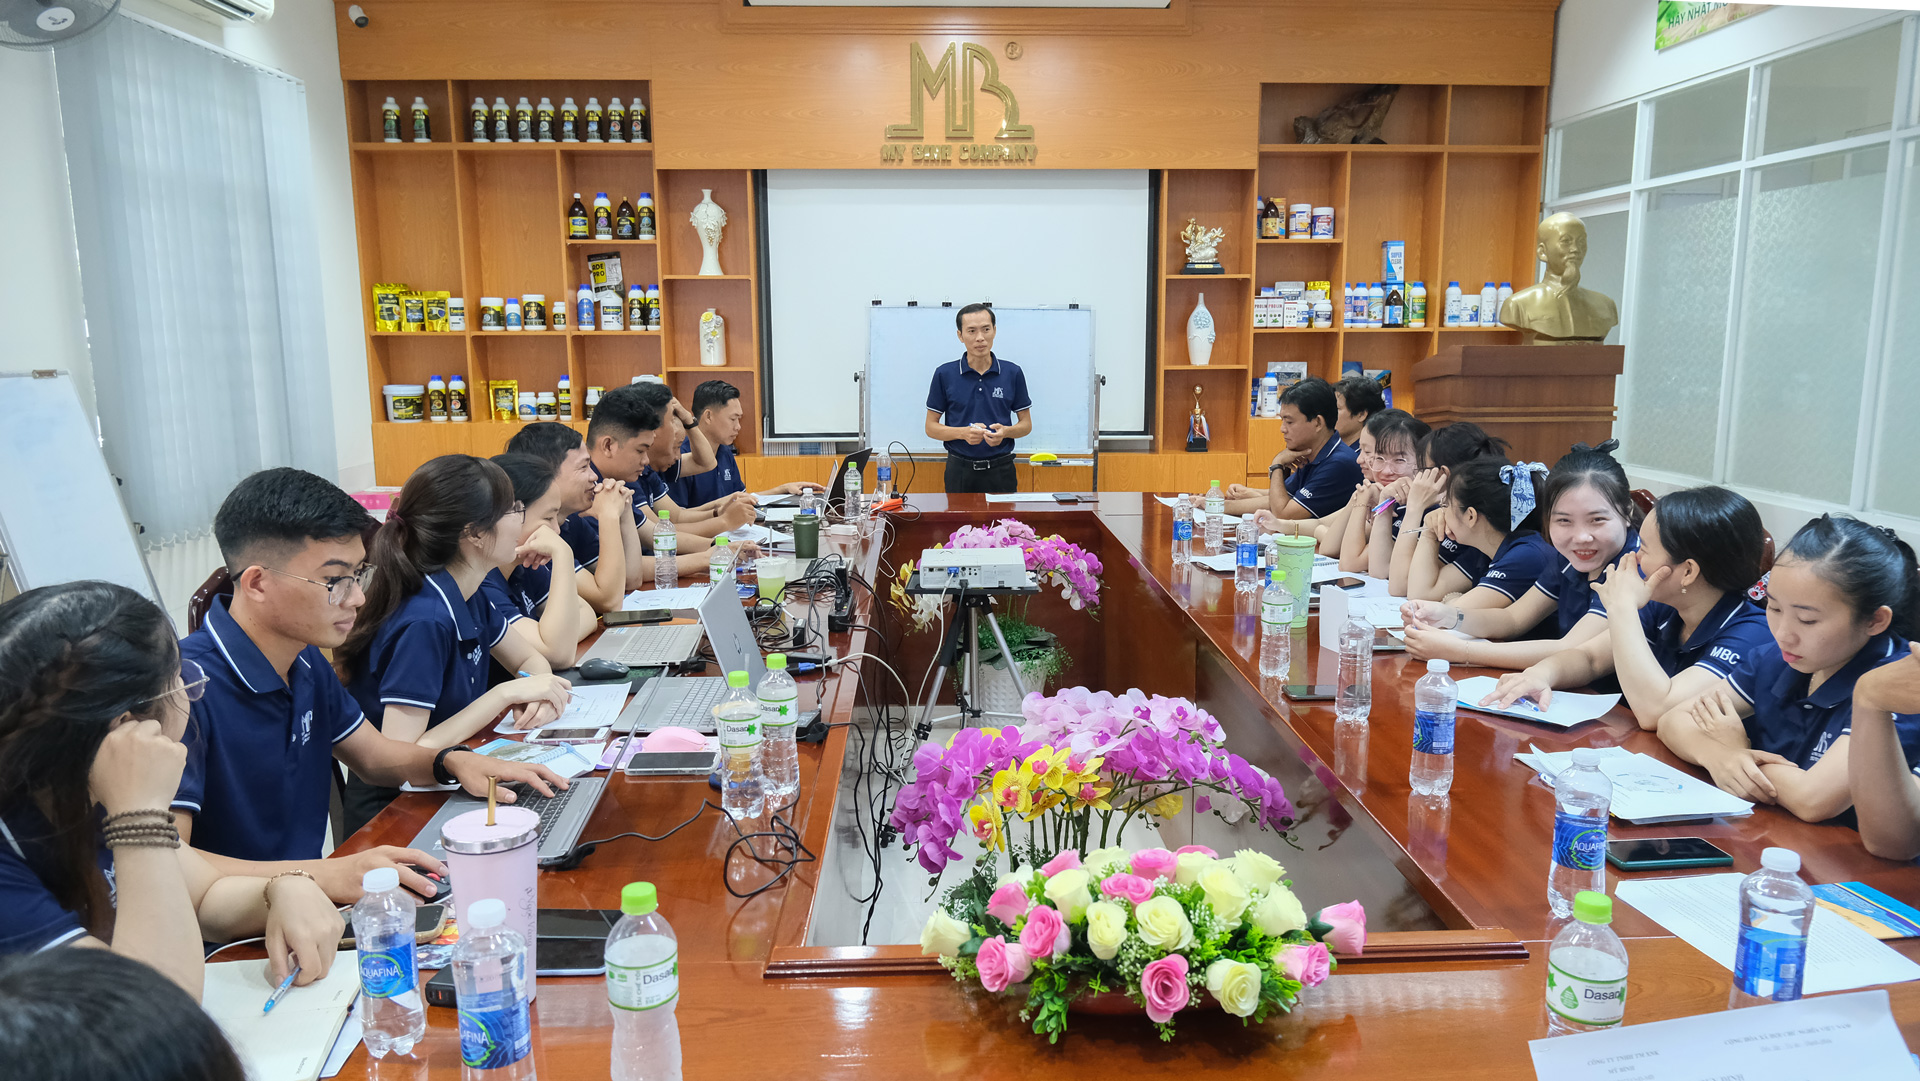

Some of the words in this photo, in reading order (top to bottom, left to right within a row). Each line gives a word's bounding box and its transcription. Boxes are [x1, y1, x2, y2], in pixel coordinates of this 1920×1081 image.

[881, 144, 906, 163] MY
[959, 144, 1038, 163] COMPANY
[1299, 487, 1313, 499] MBC
[1441, 538, 1458, 553] MBC
[1710, 646, 1740, 665] MBC
[726, 725, 749, 733] Dasan
[642, 967, 675, 985] Dasan
[1584, 988, 1622, 1001] Dasan
